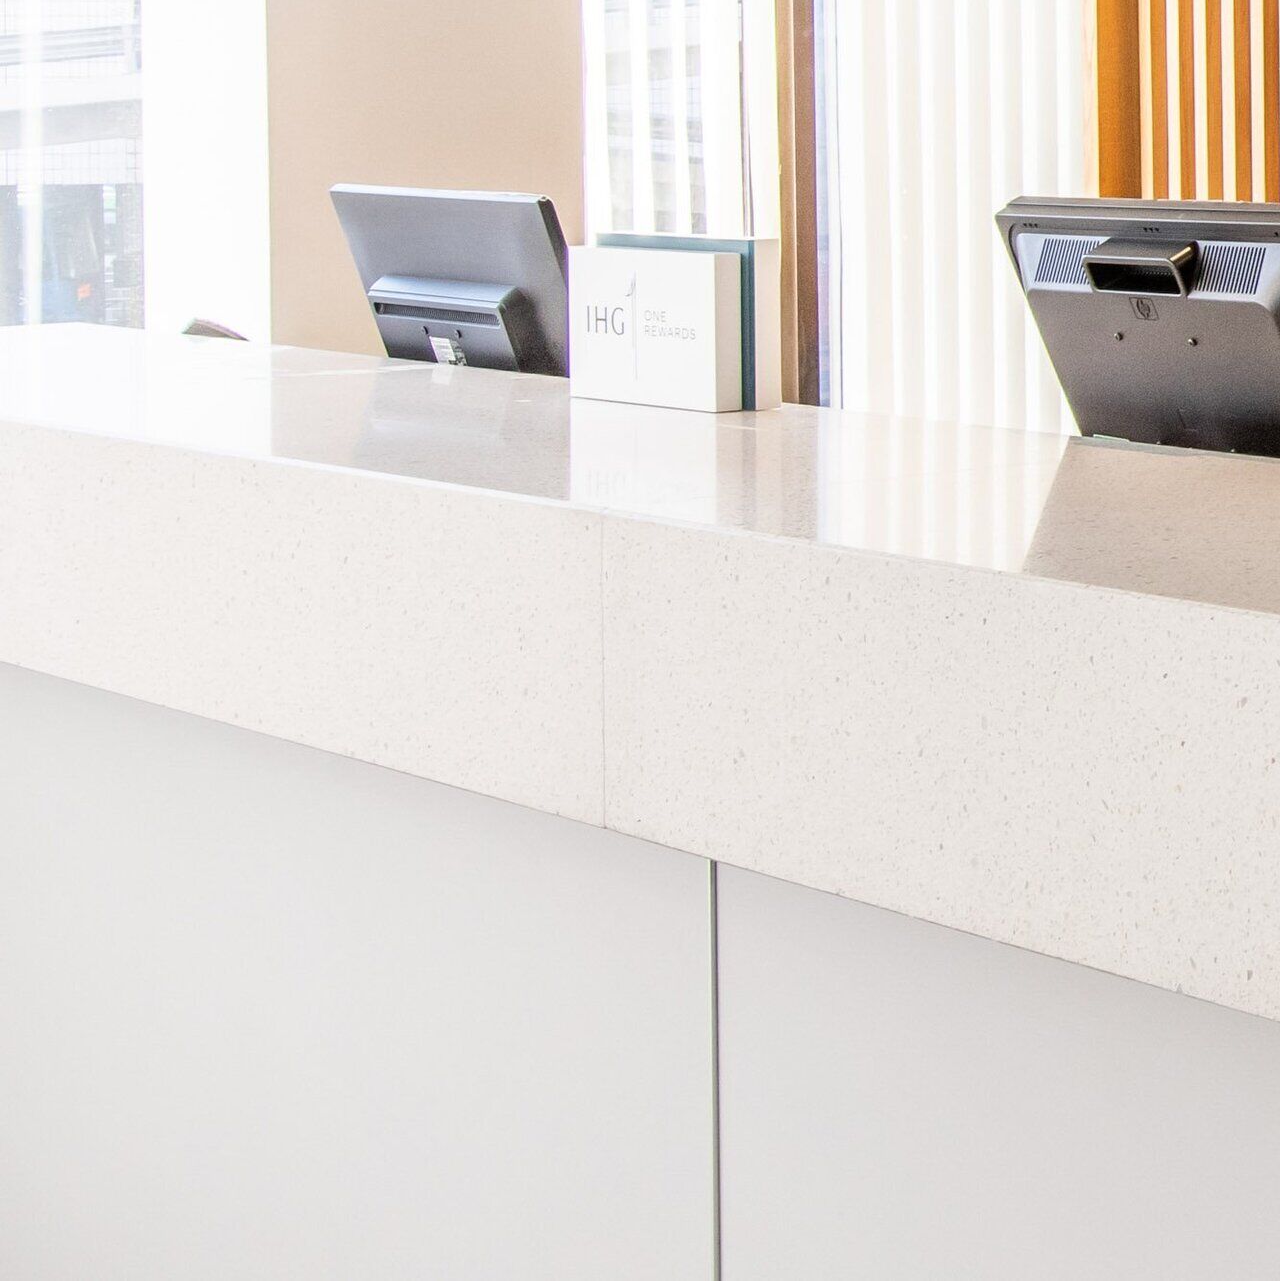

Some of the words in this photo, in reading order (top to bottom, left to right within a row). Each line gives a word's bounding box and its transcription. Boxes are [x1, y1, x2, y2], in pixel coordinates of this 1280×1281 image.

[586, 305, 625, 336] IHG
[643, 309, 667, 323] ONE
[643, 325, 697, 340] REWARDS
